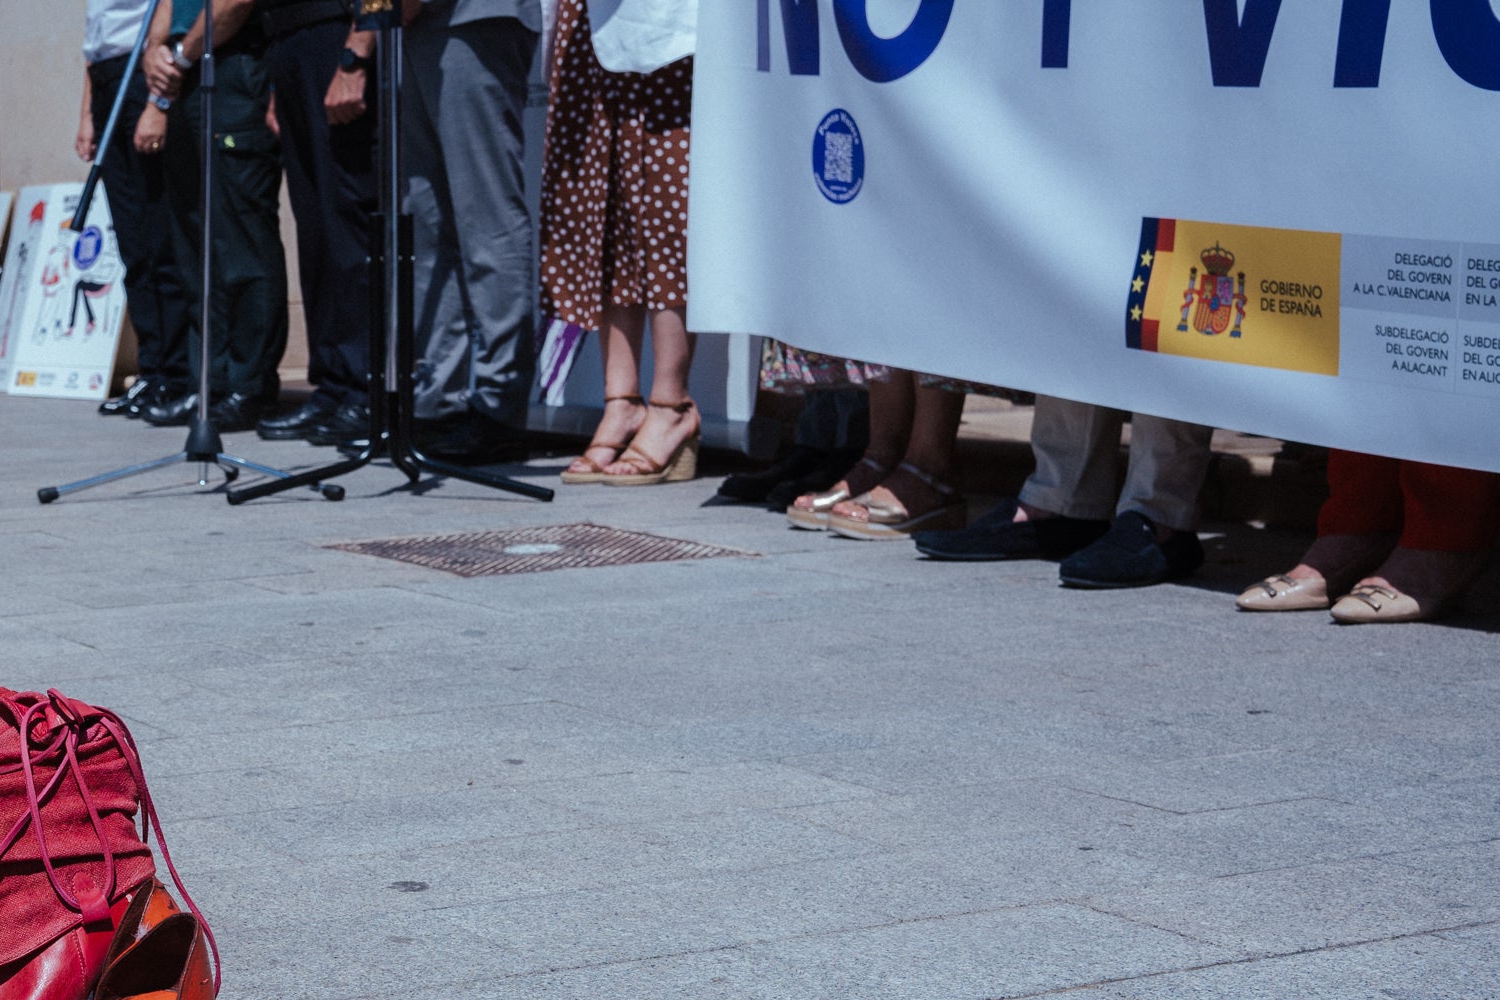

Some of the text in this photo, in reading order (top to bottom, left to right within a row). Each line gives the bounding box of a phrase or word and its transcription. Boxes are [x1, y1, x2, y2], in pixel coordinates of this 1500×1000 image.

[1394, 252, 1453, 269] DELEGACIÓ
[1387, 269, 1452, 286] DEL GOVERN
[1466, 275, 1486, 289] DEL
[1260, 279, 1323, 300] GOBIERNO
[1353, 282, 1361, 293] A
[1363, 283, 1375, 295] LA
[1260, 297, 1323, 319] DE ESPAÑA
[1465, 293, 1497, 307] EN LA
[1375, 324, 1449, 344] SUBDELEGACIÓ
[1386, 342, 1449, 361] DEL GOVERN
[1463, 352, 1483, 365] DEL
[1392, 360, 1448, 377] A ALACANT
[1462, 368, 1477, 381] EN
